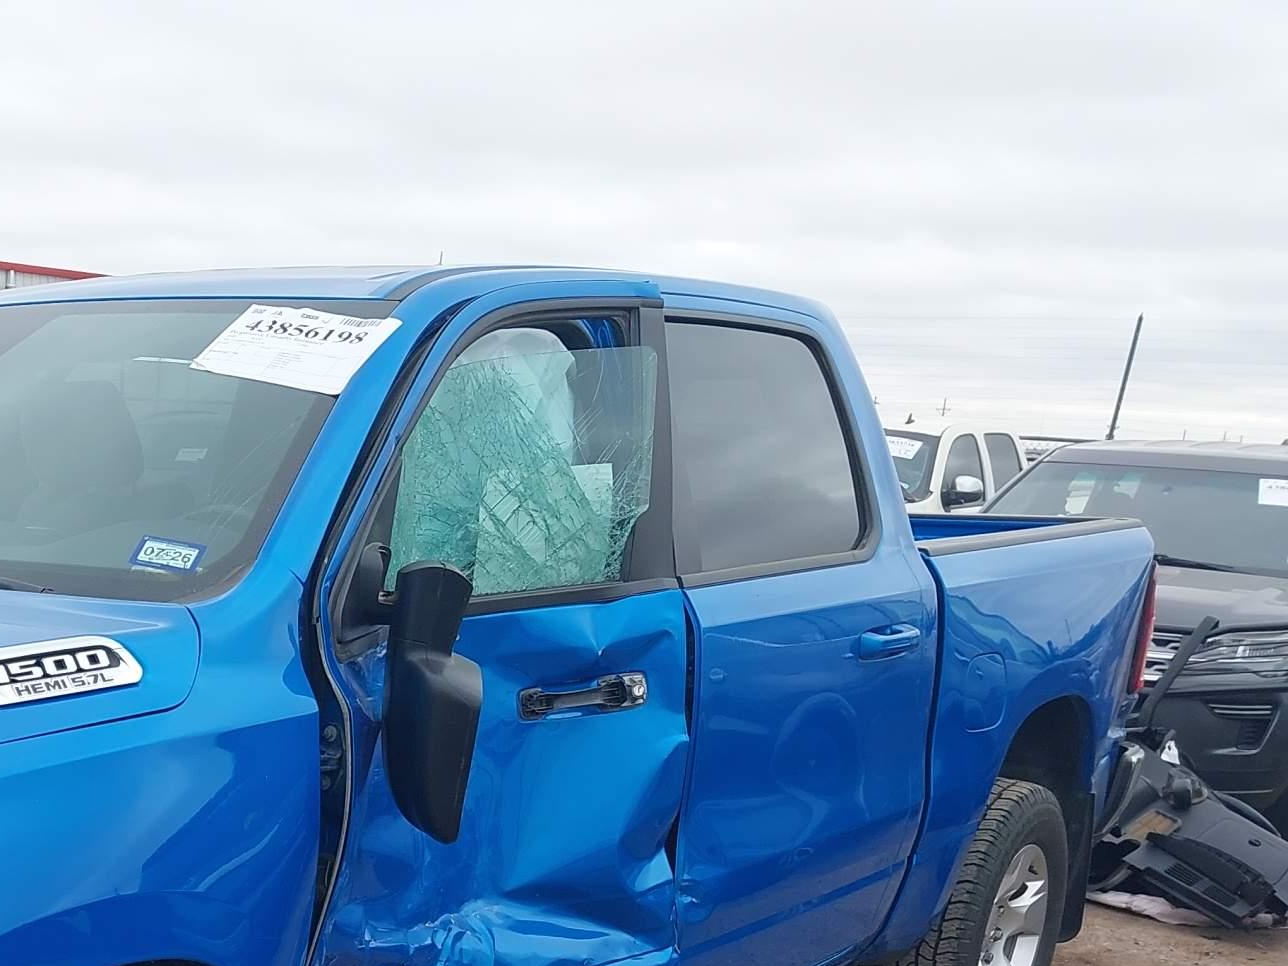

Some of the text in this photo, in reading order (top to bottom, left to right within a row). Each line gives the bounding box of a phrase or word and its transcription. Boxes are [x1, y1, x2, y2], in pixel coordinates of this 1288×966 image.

[245, 318, 369, 346] 43856198
[172, 550, 193, 564] 26
[14, 672, 115, 697] HEMI 5.7L
